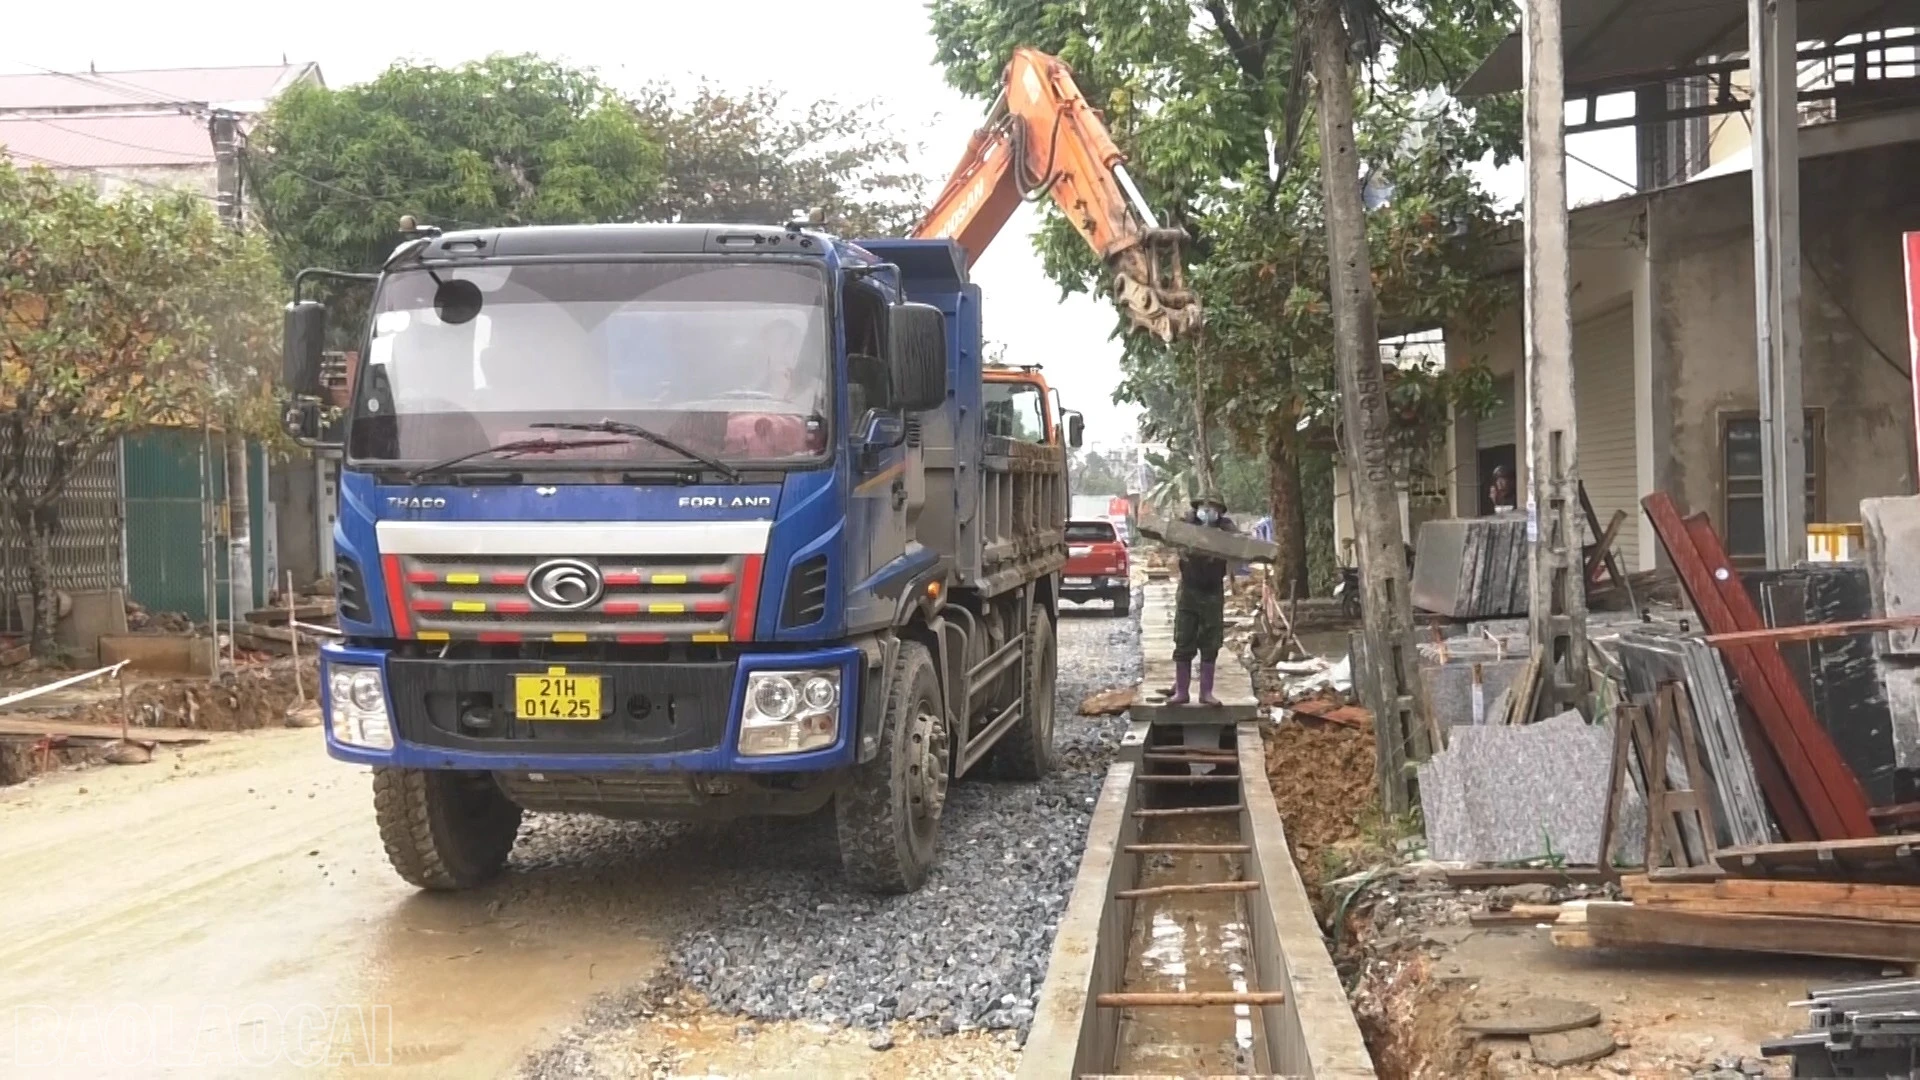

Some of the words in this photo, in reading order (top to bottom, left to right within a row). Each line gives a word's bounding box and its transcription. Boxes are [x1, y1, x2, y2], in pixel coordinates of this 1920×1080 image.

[386, 496, 446, 508] THACO
[678, 496, 771, 508] FORLAND
[540, 679, 576, 696] 21H
[525, 699, 591, 717] 014.25
